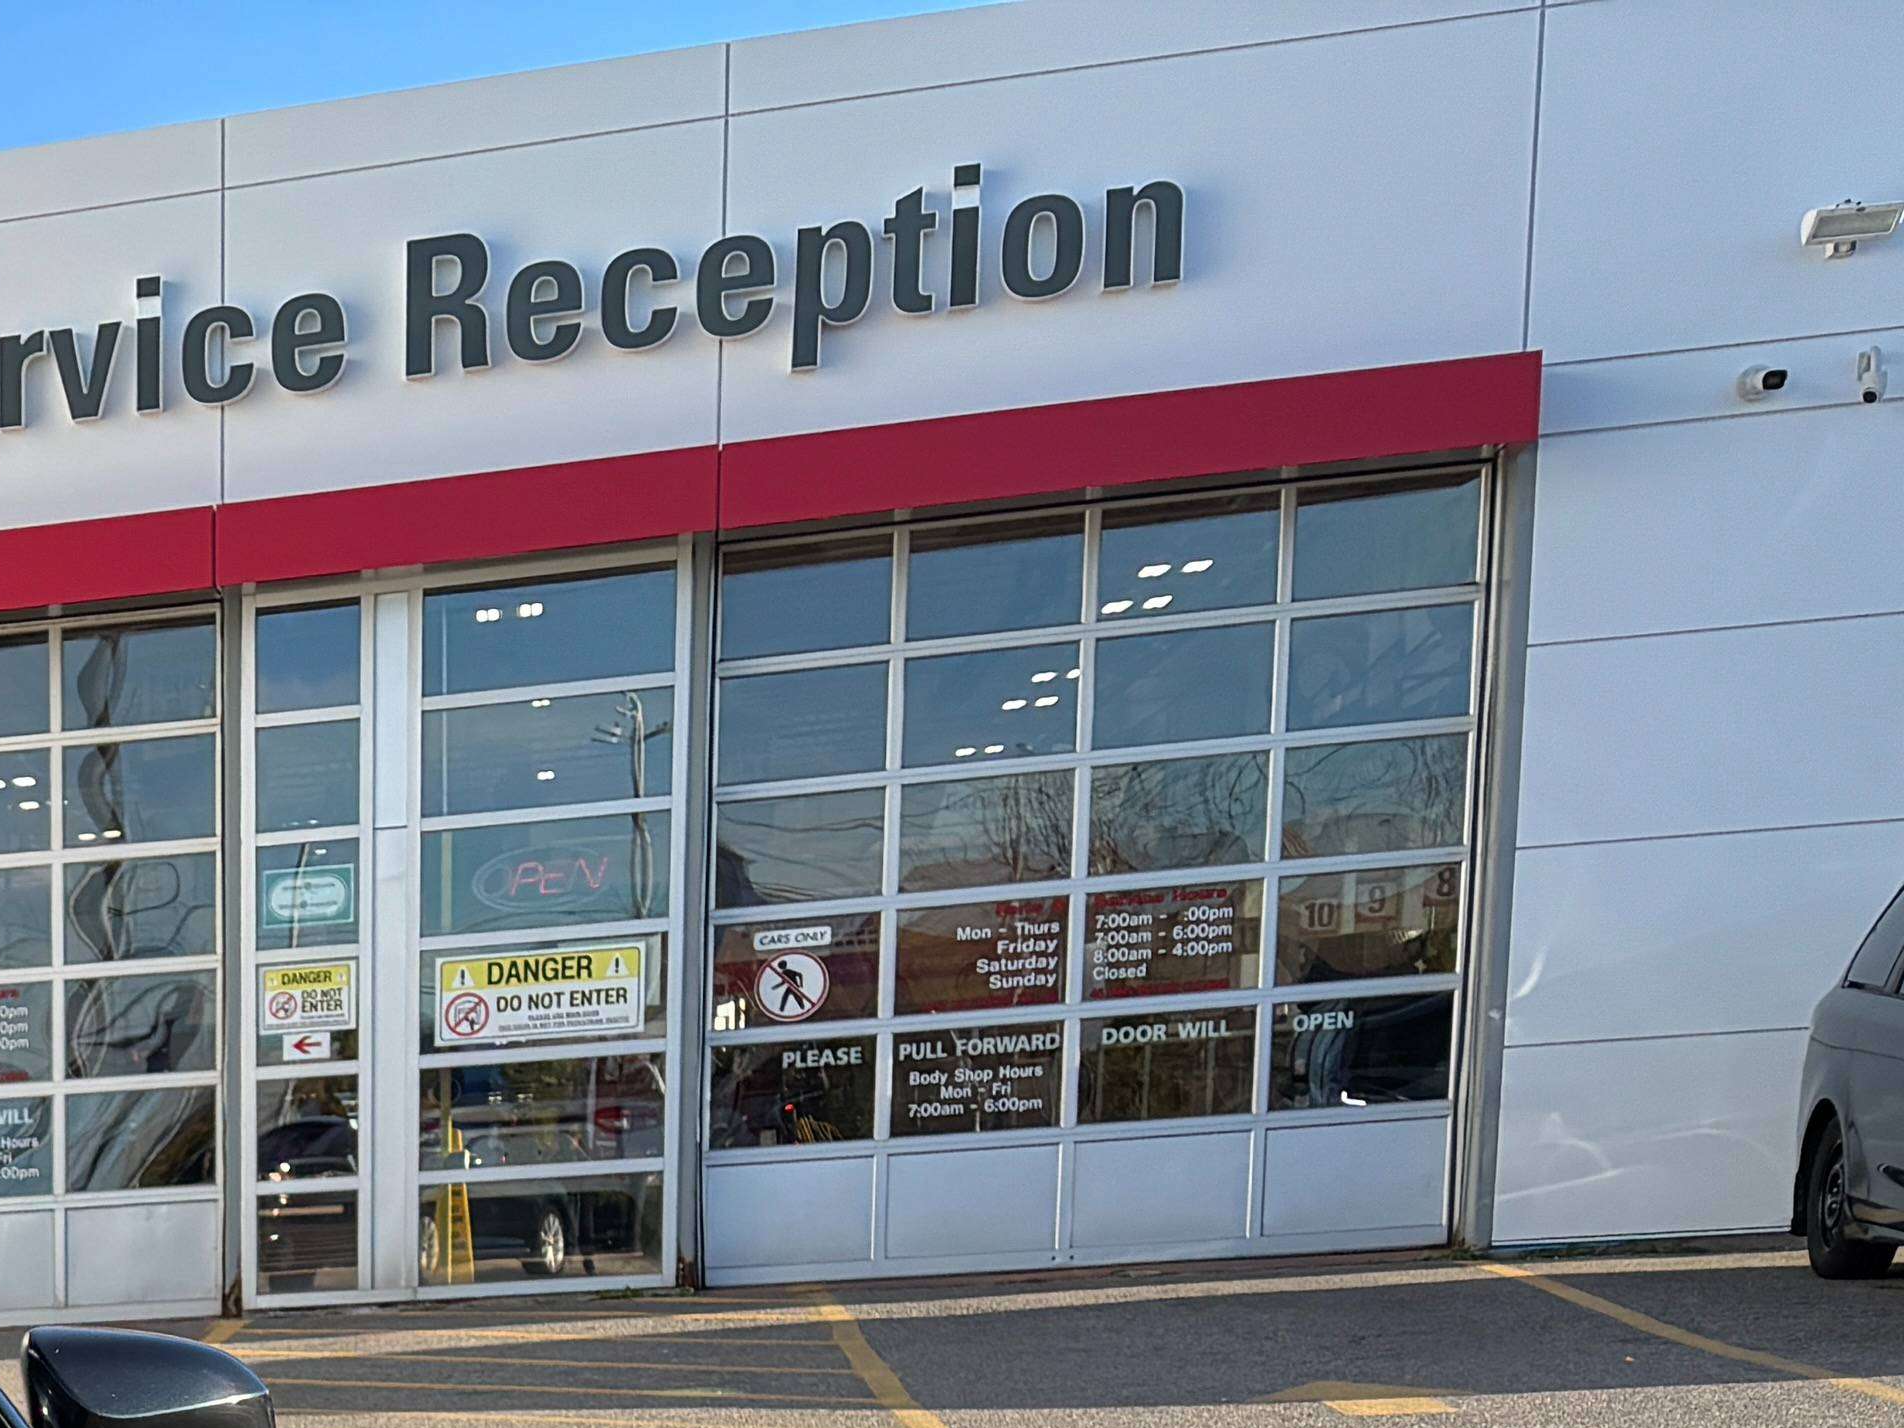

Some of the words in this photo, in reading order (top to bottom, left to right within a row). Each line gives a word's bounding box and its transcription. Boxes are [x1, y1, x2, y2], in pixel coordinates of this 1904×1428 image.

[404, 163, 1185, 376] Reception
[481, 857, 609, 897] OPEN
[1437, 867, 1456, 897] 8
[1368, 885, 1386, 914] 9
[956, 926, 992, 941] Mon
[1014, 921, 1060, 936] Thurs
[1095, 912, 1152, 929] 7:00am
[1305, 901, 1334, 928] 10
[759, 933, 790, 946] CARS
[795, 929, 828, 944] ONLY
[997, 937, 1058, 954] Friday
[1095, 930, 1152, 946] 7:00am
[1172, 923, 1232, 940] 6:00pm
[487, 955, 593, 986] DANGER
[976, 955, 1059, 974] Saturday
[1093, 947, 1152, 963] 8:00am
[1172, 940, 1232, 957] 4:00pm
[281, 970, 333, 986] DANGER
[989, 972, 1057, 990] Sunday
[1093, 962, 1147, 980] Closed
[301, 989, 318, 1000] DO
[321, 987, 343, 999] NOT
[301, 999, 343, 1013] ENTER
[496, 995, 522, 1013] DO
[528, 991, 565, 1010] NOT
[570, 987, 628, 1007] ENTER
[782, 1046, 862, 1069] PLEASE
[899, 1041, 948, 1061] PULL
[956, 1032, 1060, 1057] FORWARD
[1102, 1023, 1167, 1046] DOOR
[1177, 1019, 1232, 1039] WILL
[1293, 1010, 1354, 1032] OPEN
[909, 1070, 948, 1086] Body
[954, 1067, 993, 1083] Shop
[999, 1064, 1043, 1079] Hours
[940, 1085, 972, 1099] Mon
[992, 1081, 1011, 1095] Fri
[908, 1102, 964, 1118] 7:00am
[984, 1097, 1042, 1112] 6:00pm
[1, 1135, 40, 1149] Hours
